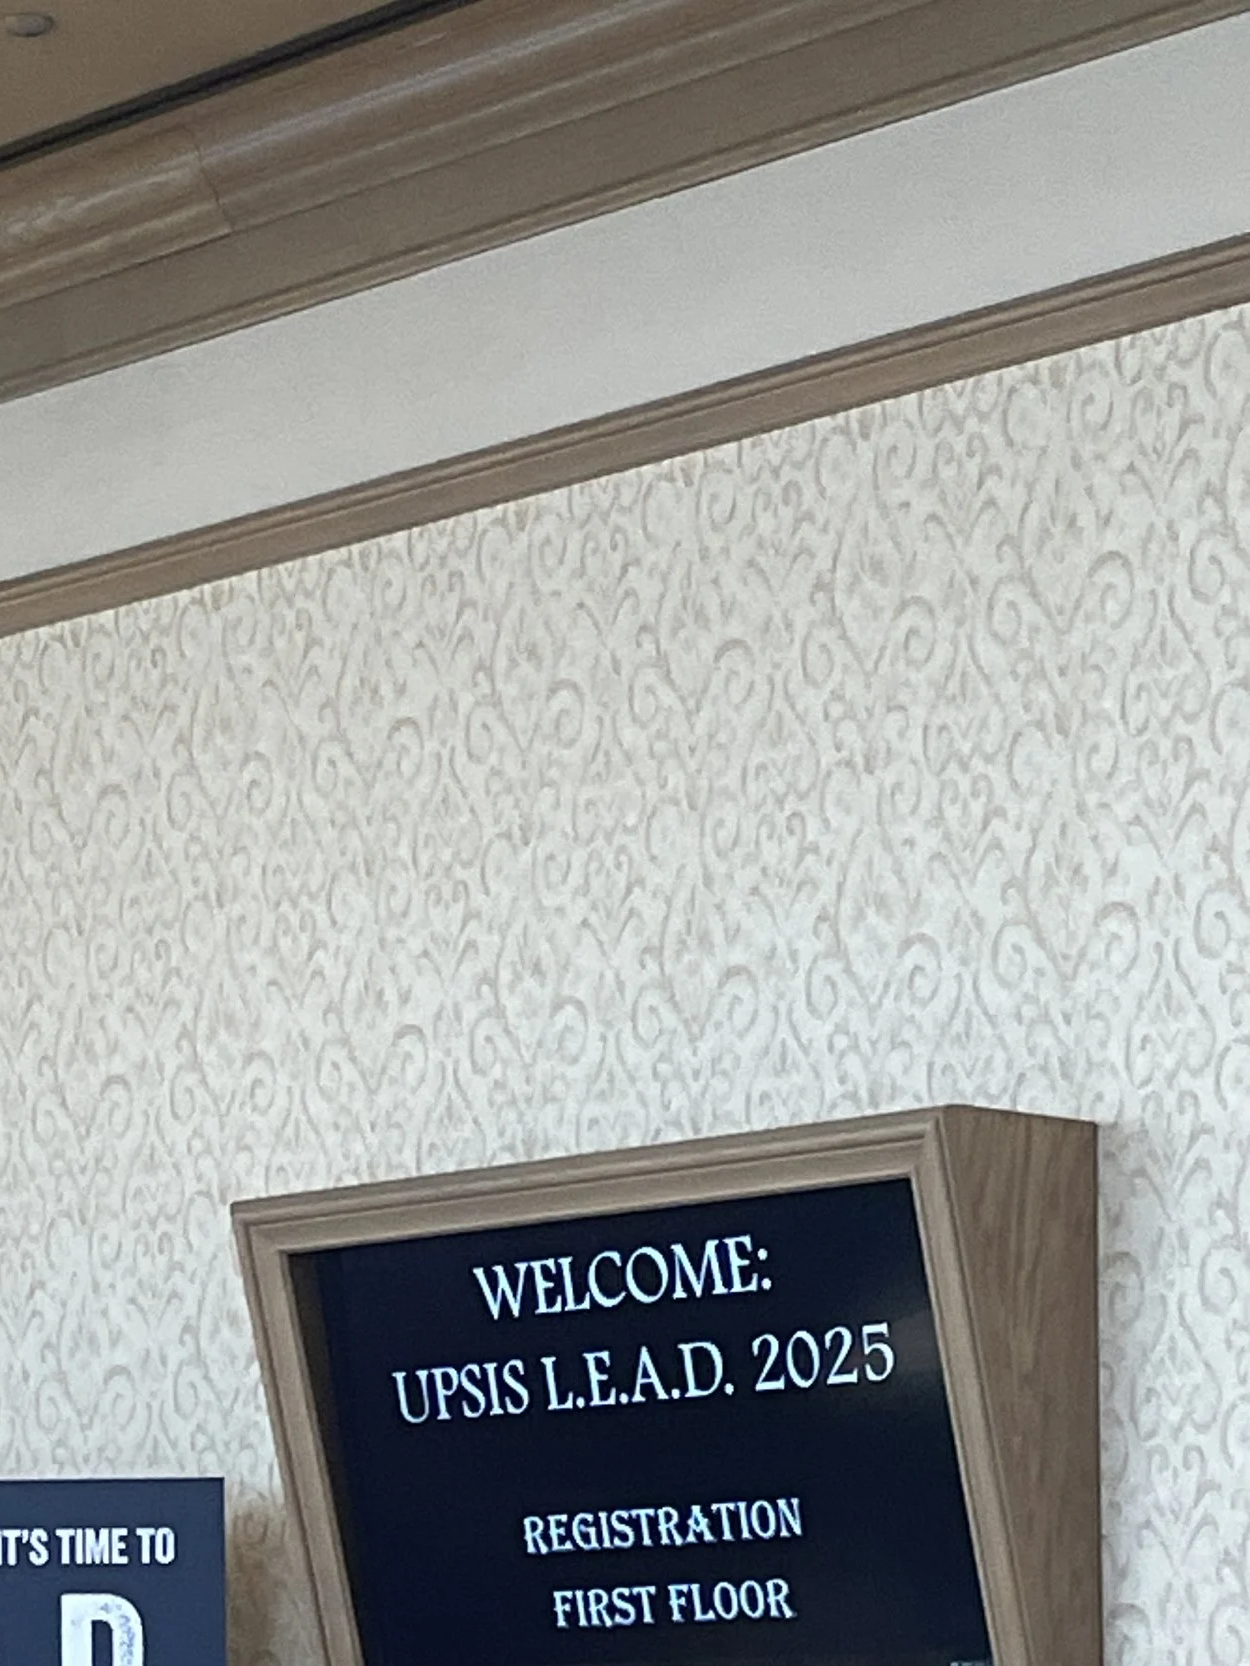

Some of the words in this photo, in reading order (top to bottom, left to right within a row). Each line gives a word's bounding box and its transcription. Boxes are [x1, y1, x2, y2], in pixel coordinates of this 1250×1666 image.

[473, 1234, 773, 1320] WELCOME:
[392, 1359, 530, 1424] UPSIS
[540, 1339, 735, 1412] L.E.A.D.
[752, 1322, 895, 1393] 2025
[55, 1528, 128, 1565] TIME
[137, 1528, 176, 1564] TO
[523, 1498, 804, 1556] REGISTRATION
[553, 1585, 657, 1629] FIRST
[667, 1578, 796, 1625] FLOOR
